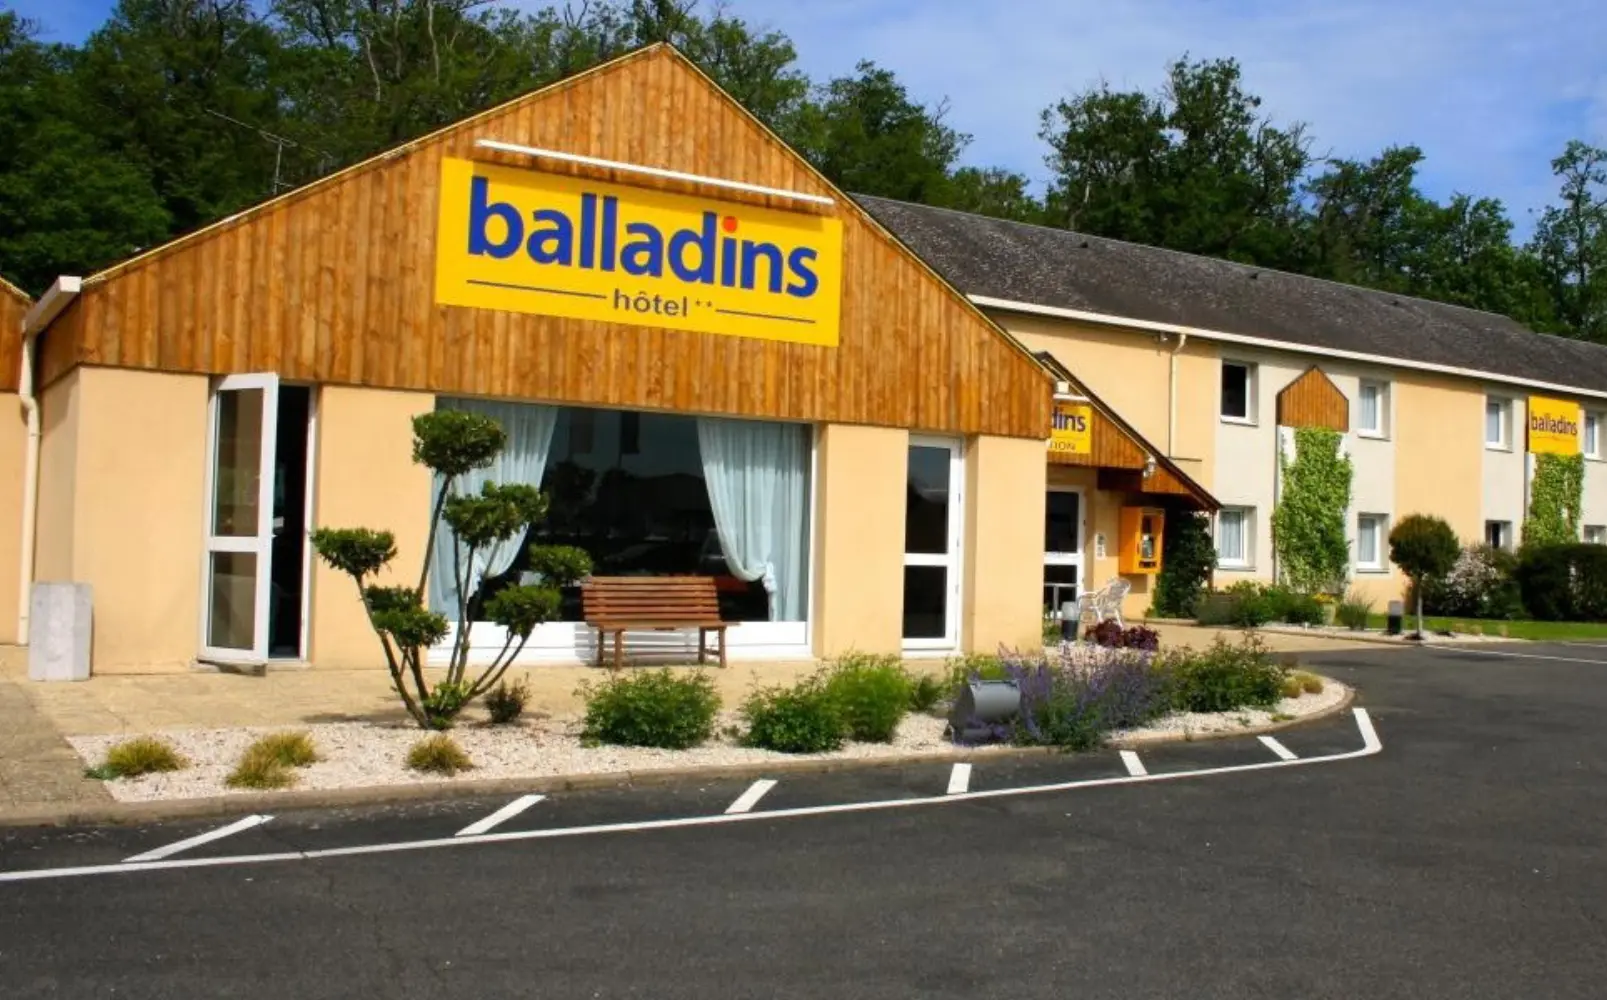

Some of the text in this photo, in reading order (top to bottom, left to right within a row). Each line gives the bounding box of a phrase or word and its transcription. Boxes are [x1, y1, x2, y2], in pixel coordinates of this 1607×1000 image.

[468, 176, 819, 298] balladins
[613, 288, 688, 318] hôtel
[1530, 411, 1578, 436] balladins
